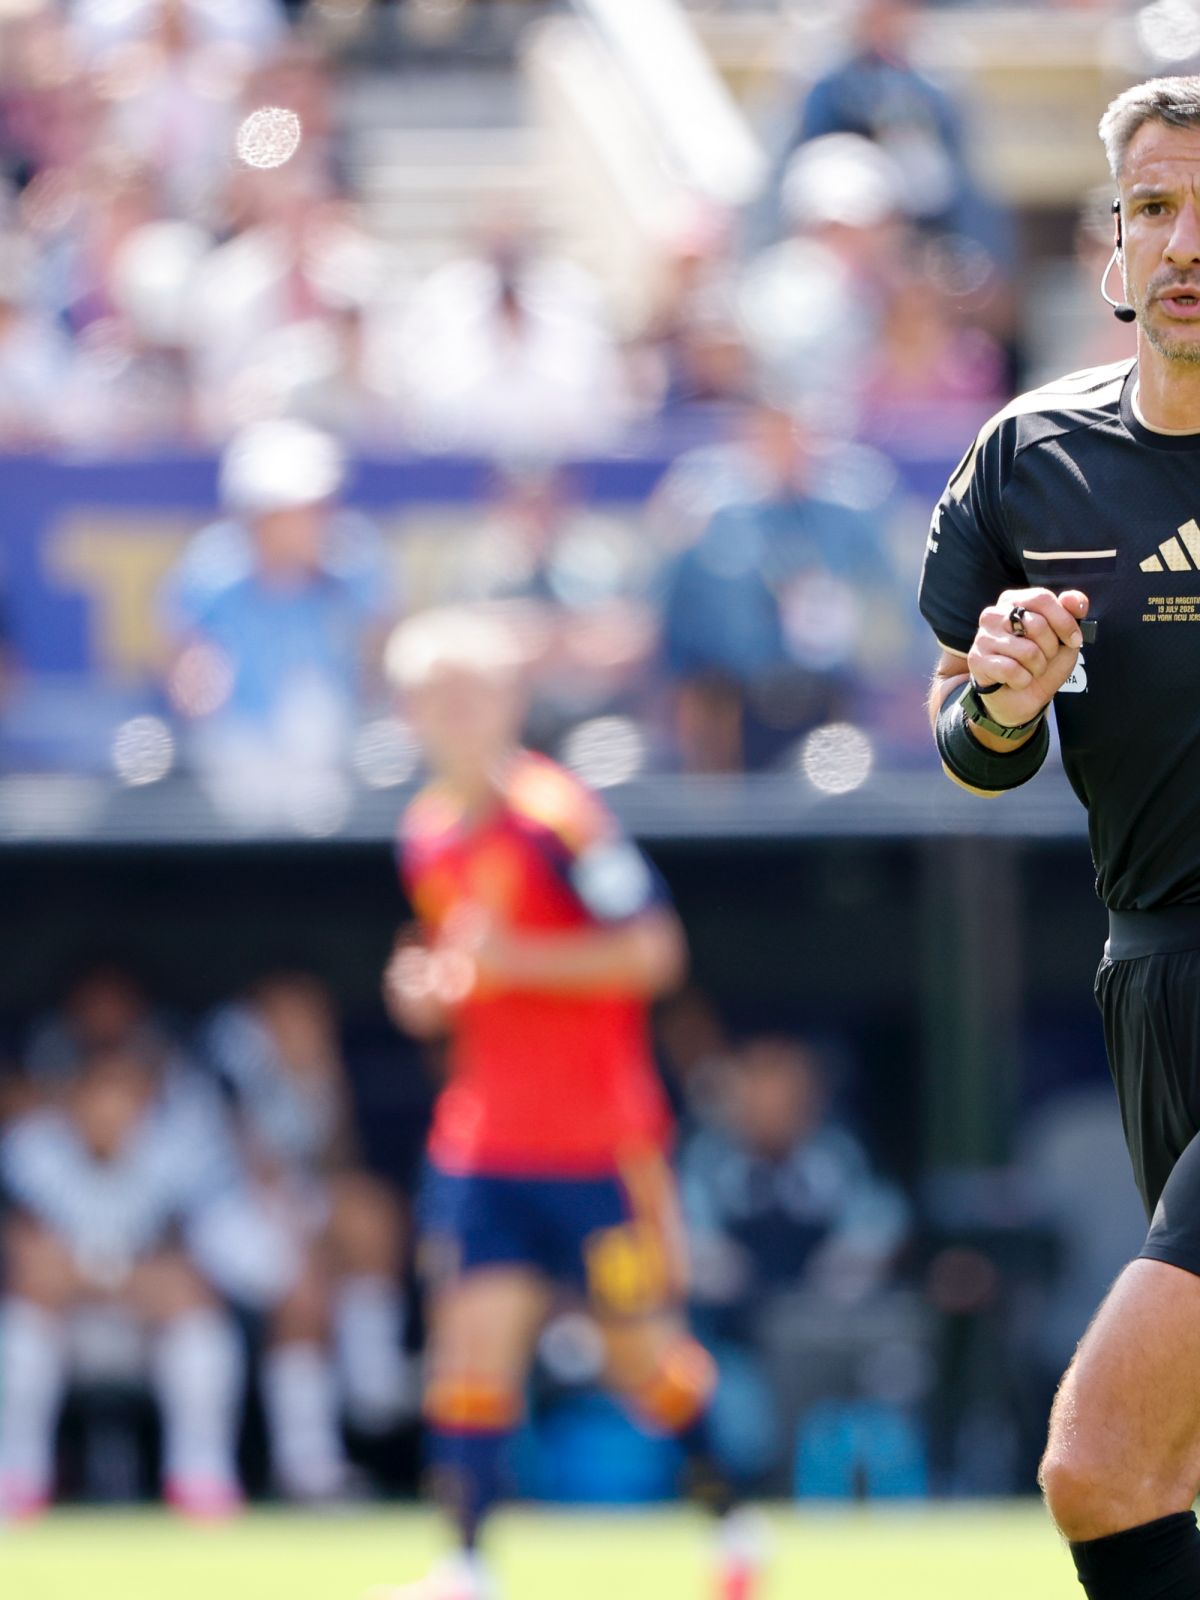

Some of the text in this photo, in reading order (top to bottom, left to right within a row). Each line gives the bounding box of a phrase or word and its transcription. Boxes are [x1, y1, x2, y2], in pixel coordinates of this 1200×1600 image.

[1142, 614, 1156, 622] NEW
[1157, 614, 1172, 622] YORK
[1174, 614, 1188, 622] NEW
